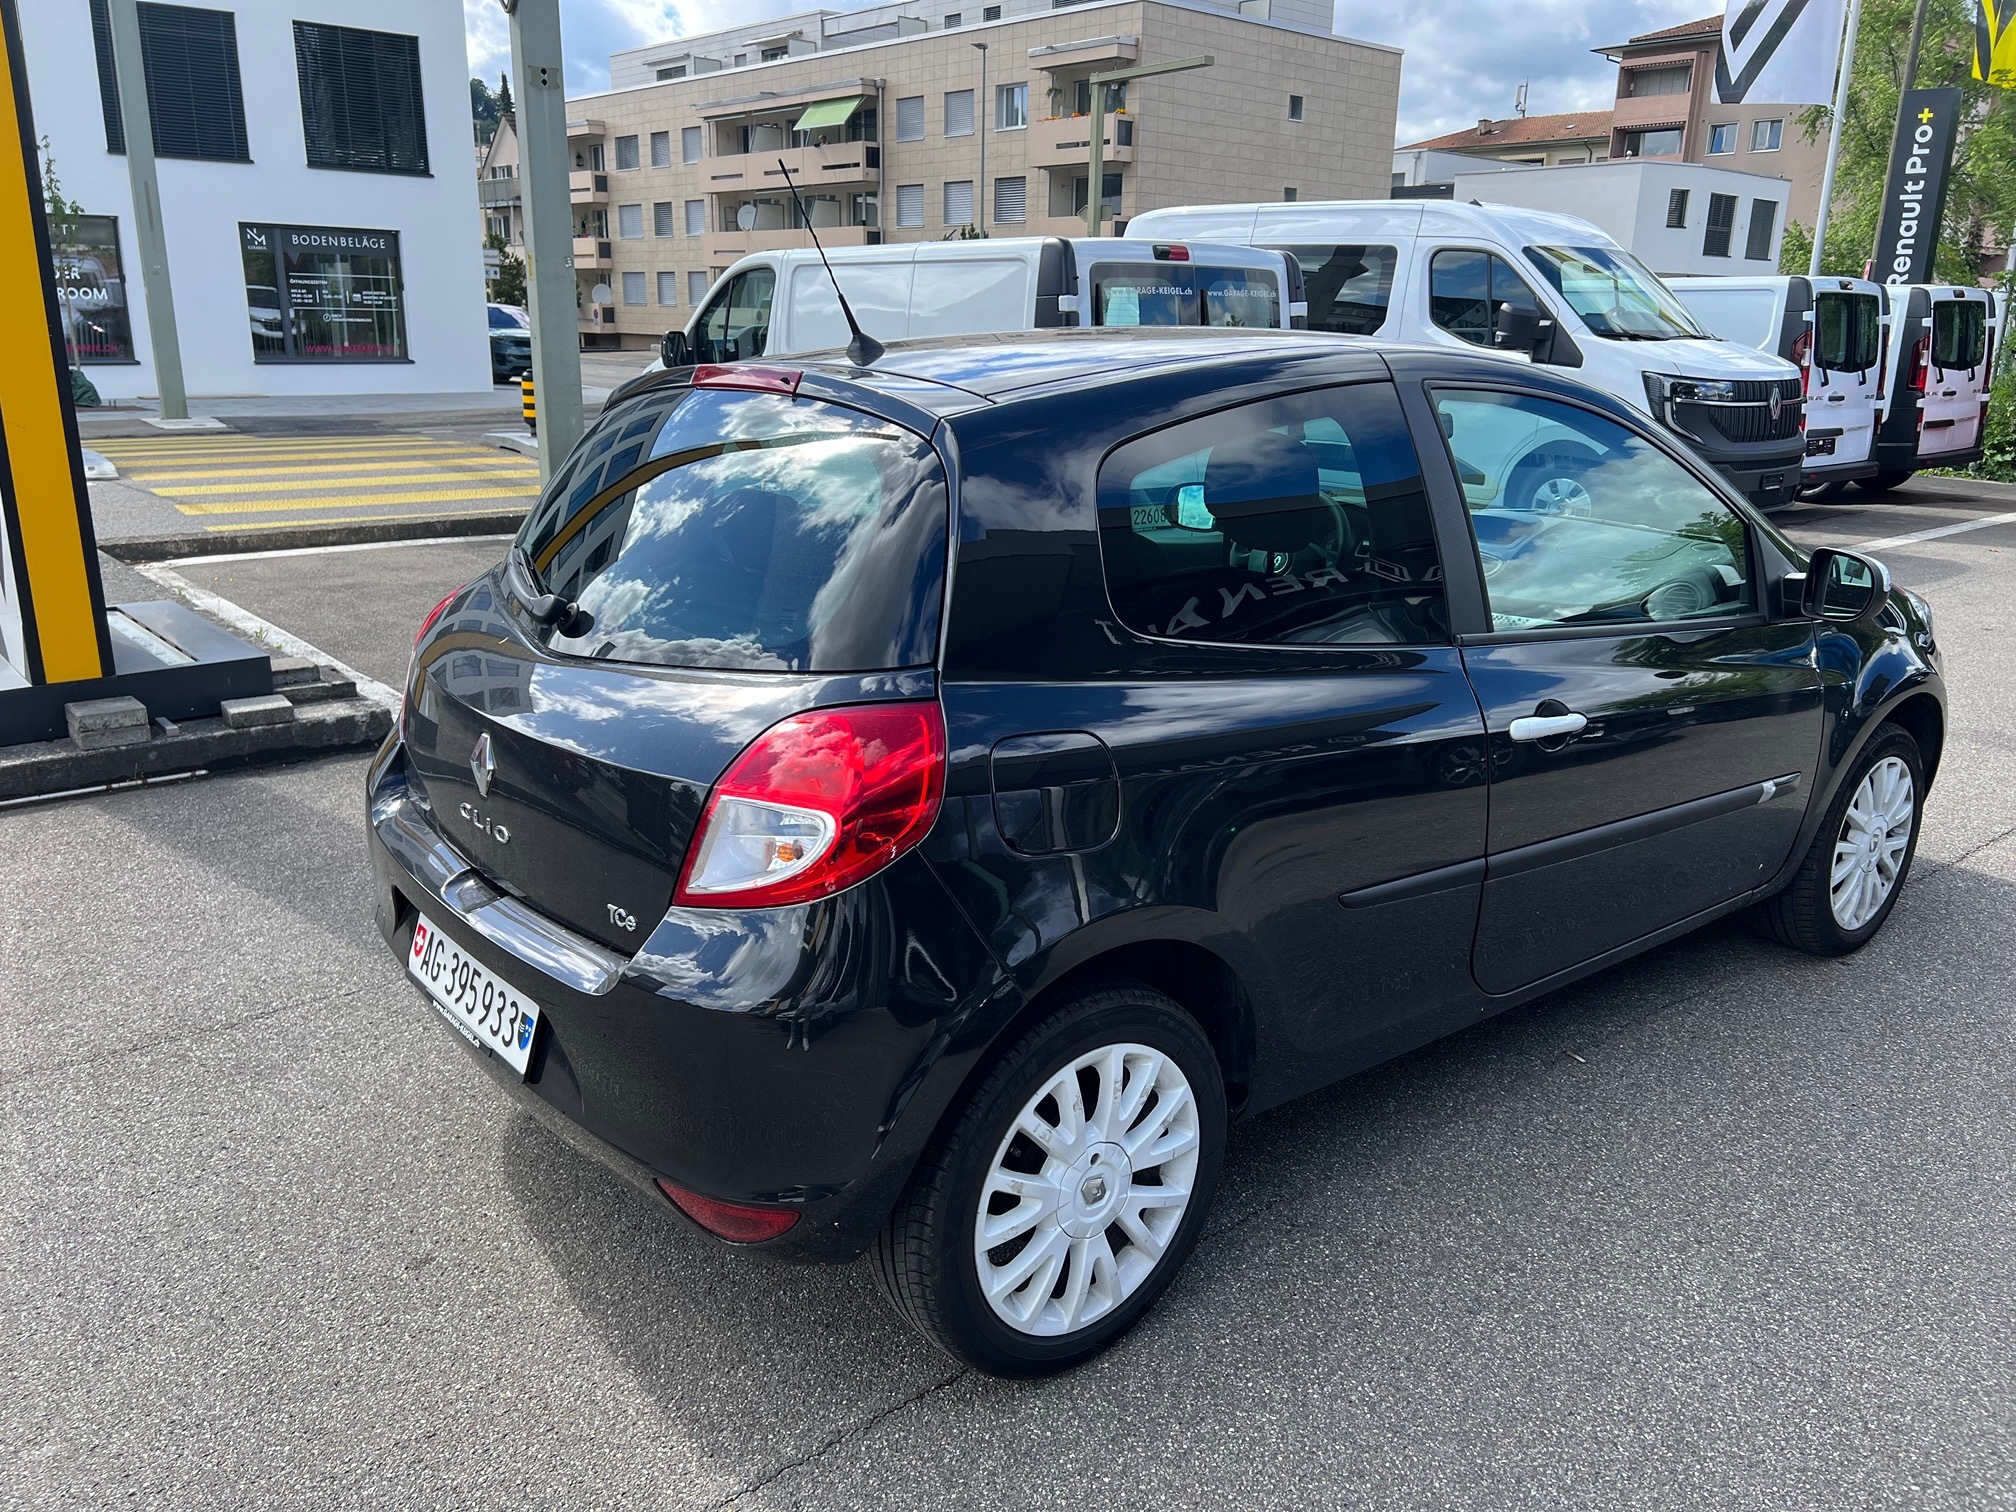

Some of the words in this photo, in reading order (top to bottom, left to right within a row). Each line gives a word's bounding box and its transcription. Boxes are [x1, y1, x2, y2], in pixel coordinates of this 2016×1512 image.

[1905, 107, 1934, 174] Pro+
[291, 233, 386, 249] BODENBELÄGE
[1886, 179, 1925, 286] Renault
[1207, 288, 1277, 298] www.GARAGE-KEIGEL.ch
[459, 802, 511, 844] CLIO
[606, 902, 639, 933] TCe
